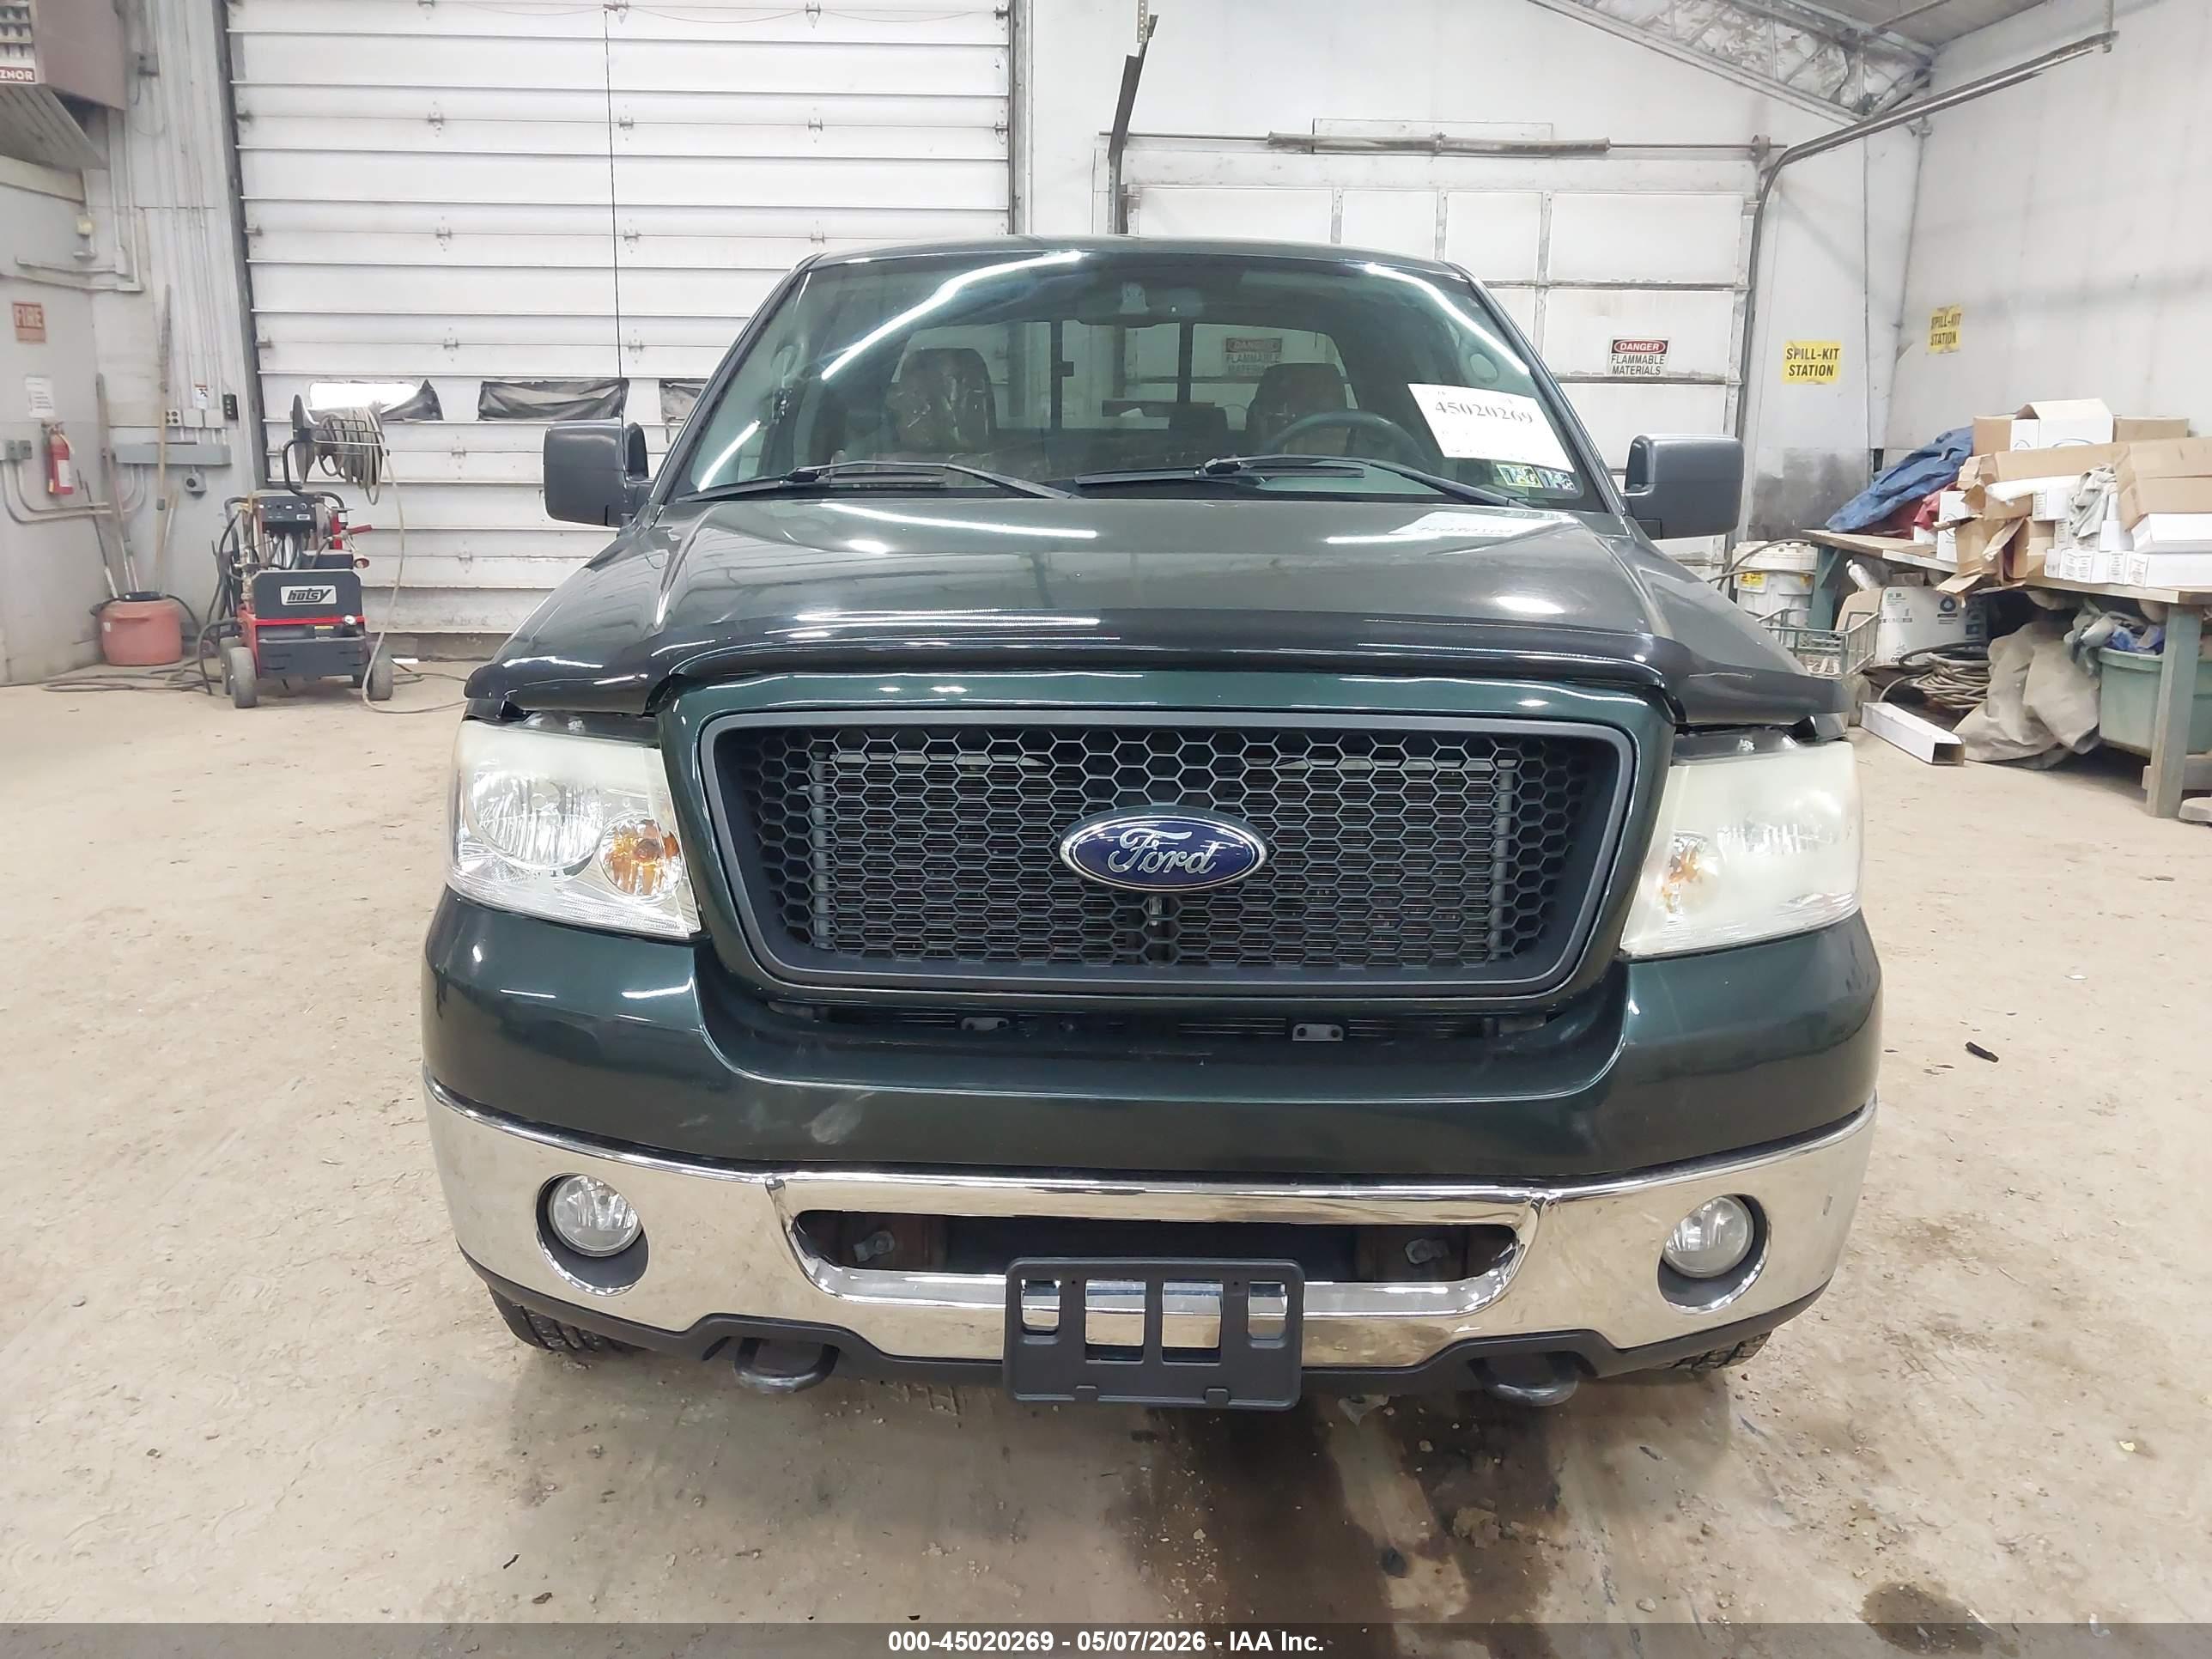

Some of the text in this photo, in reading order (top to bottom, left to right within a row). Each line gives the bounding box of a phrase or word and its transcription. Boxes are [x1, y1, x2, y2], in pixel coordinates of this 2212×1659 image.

[1930, 331, 1957, 346] STATION
[1620, 343, 1660, 351] DANGER
[1611, 355, 1666, 365] FLAMMABLE
[1786, 348, 1840, 360] SPILL-KIT
[1612, 365, 1662, 375] MATERIALS
[1789, 364, 1834, 377] STATION
[1435, 401, 1534, 424] 45020269
[1107, 827, 1217, 874] Ford
